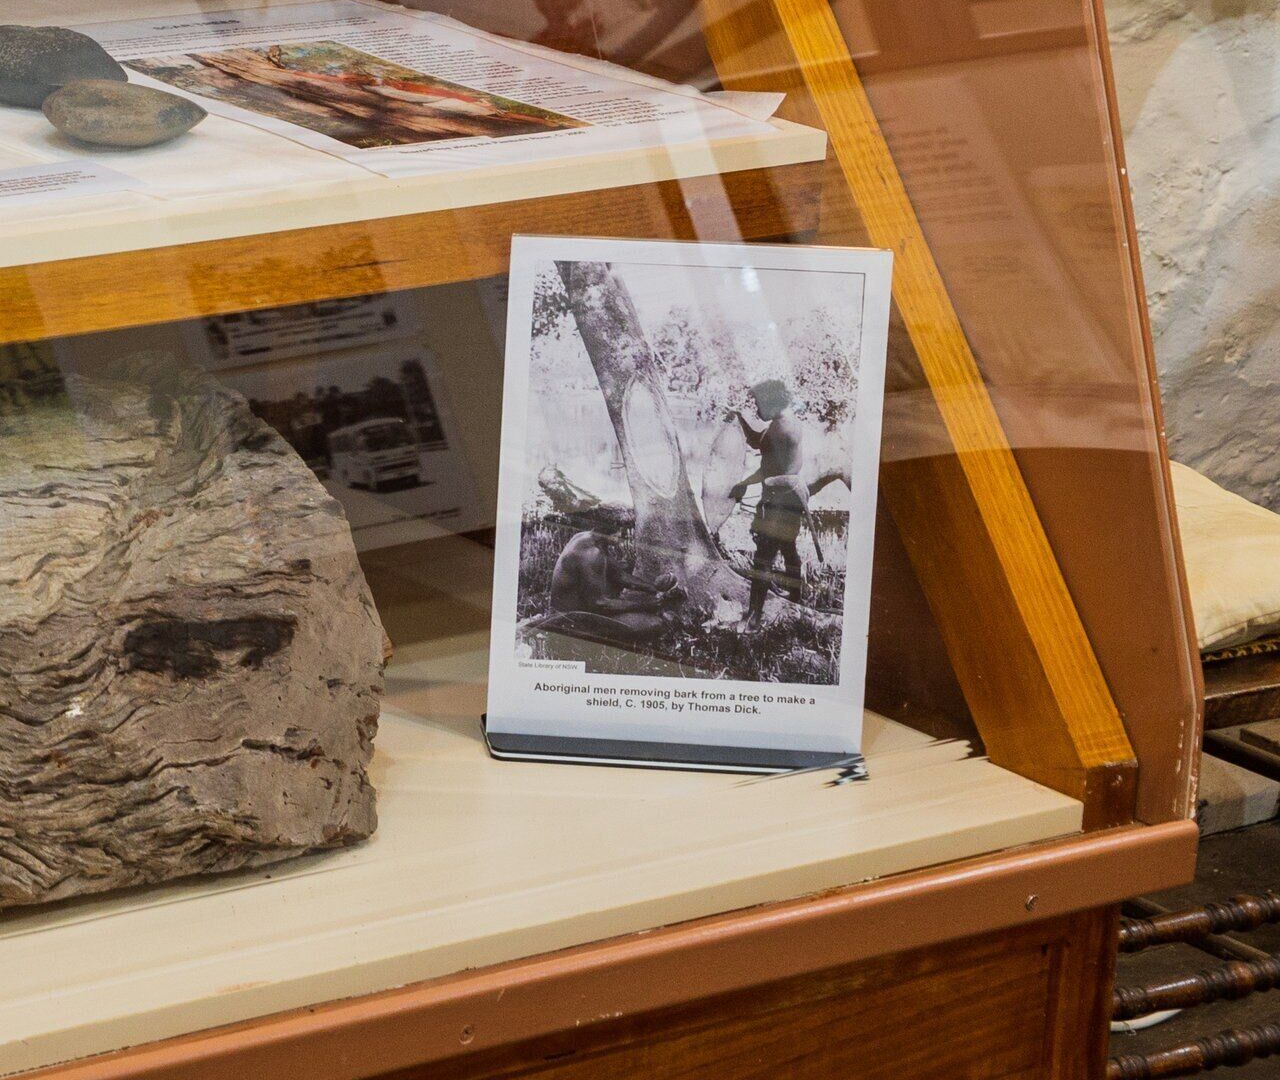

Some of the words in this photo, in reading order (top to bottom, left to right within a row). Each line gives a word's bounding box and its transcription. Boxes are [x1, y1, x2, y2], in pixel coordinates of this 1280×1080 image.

[534, 682, 590, 695] Aboriginal
[620, 687, 670, 699] removing
[674, 689, 697, 699] bark
[701, 690, 725, 700] from
[738, 693, 759, 702] tree
[763, 694, 773, 702] to
[777, 694, 805, 704] make
[586, 697, 621, 708] shield,
[625, 698, 636, 708] C.
[641, 699, 668, 710] 1905,
[671, 701, 684, 712] by
[689, 702, 730, 712] Thomas
[734, 704, 760, 714] Dick.
